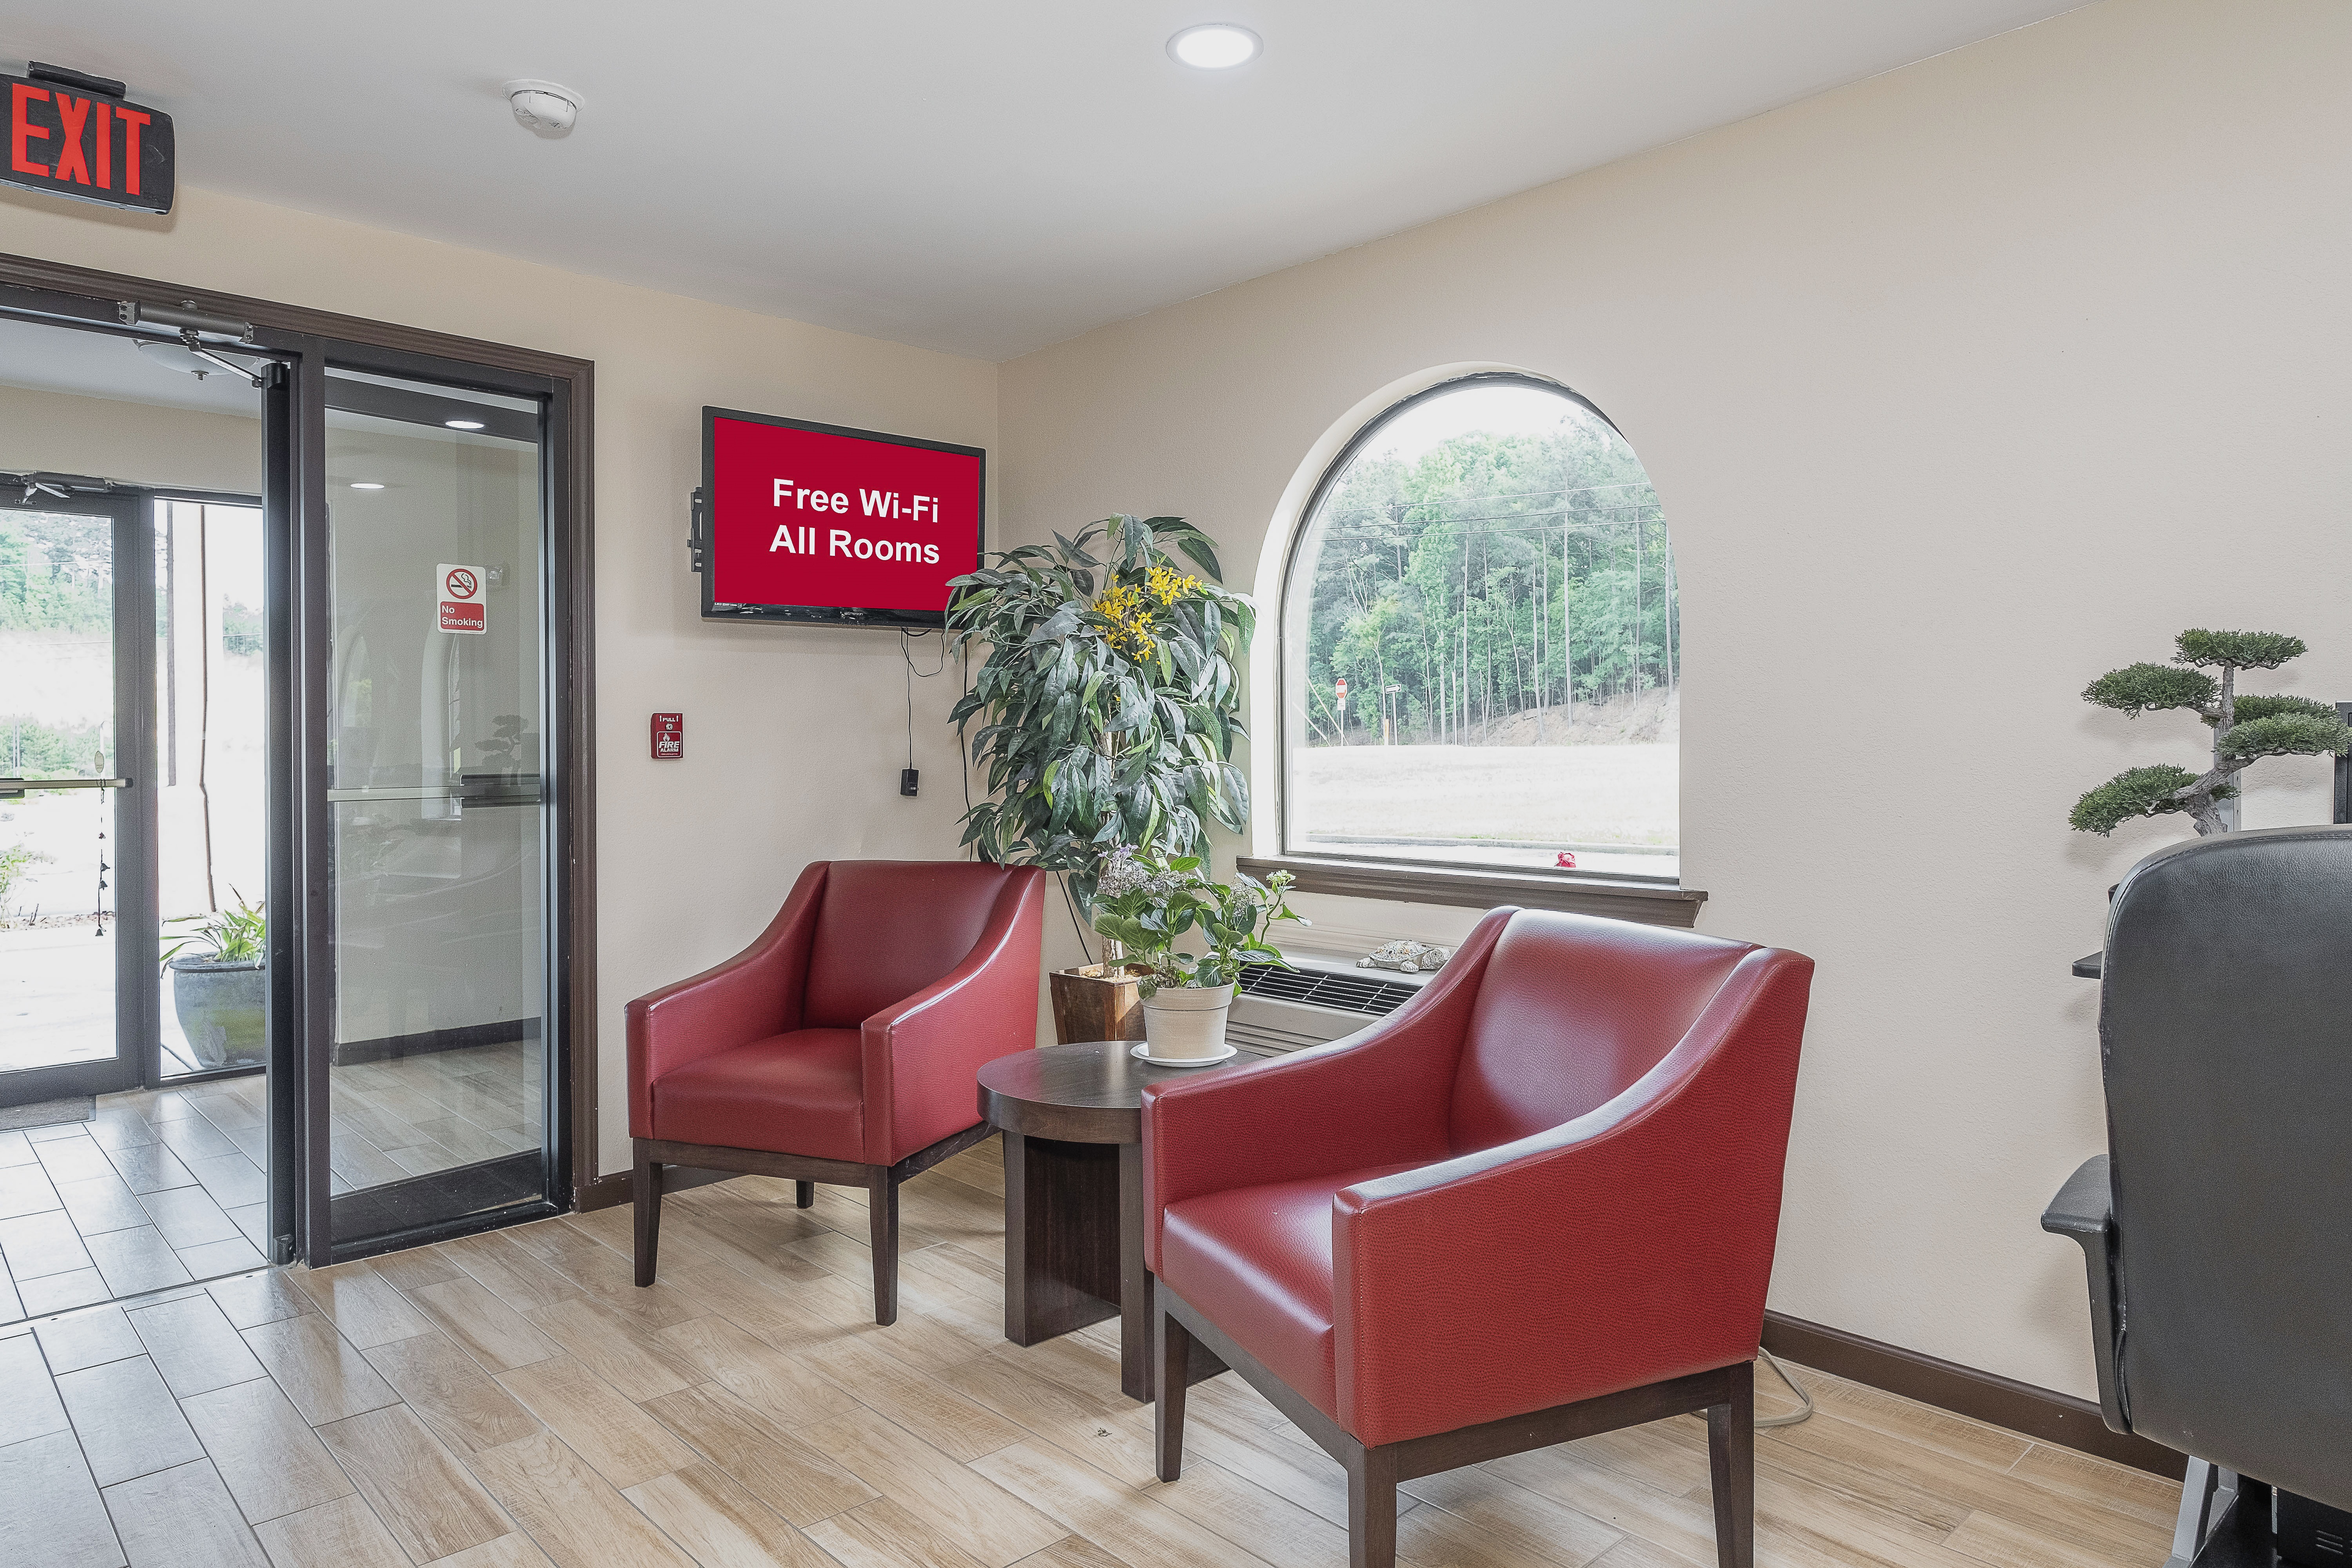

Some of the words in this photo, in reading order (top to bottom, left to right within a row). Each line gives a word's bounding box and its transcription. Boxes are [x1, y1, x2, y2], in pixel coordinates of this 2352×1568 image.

[12, 83, 151, 196] EXIT
[773, 478, 849, 514] Free
[859, 488, 938, 523] Wi-Fi
[769, 524, 816, 555] All
[829, 529, 940, 564] Rooms
[442, 605, 455, 613] No
[442, 617, 483, 628] Smoking
